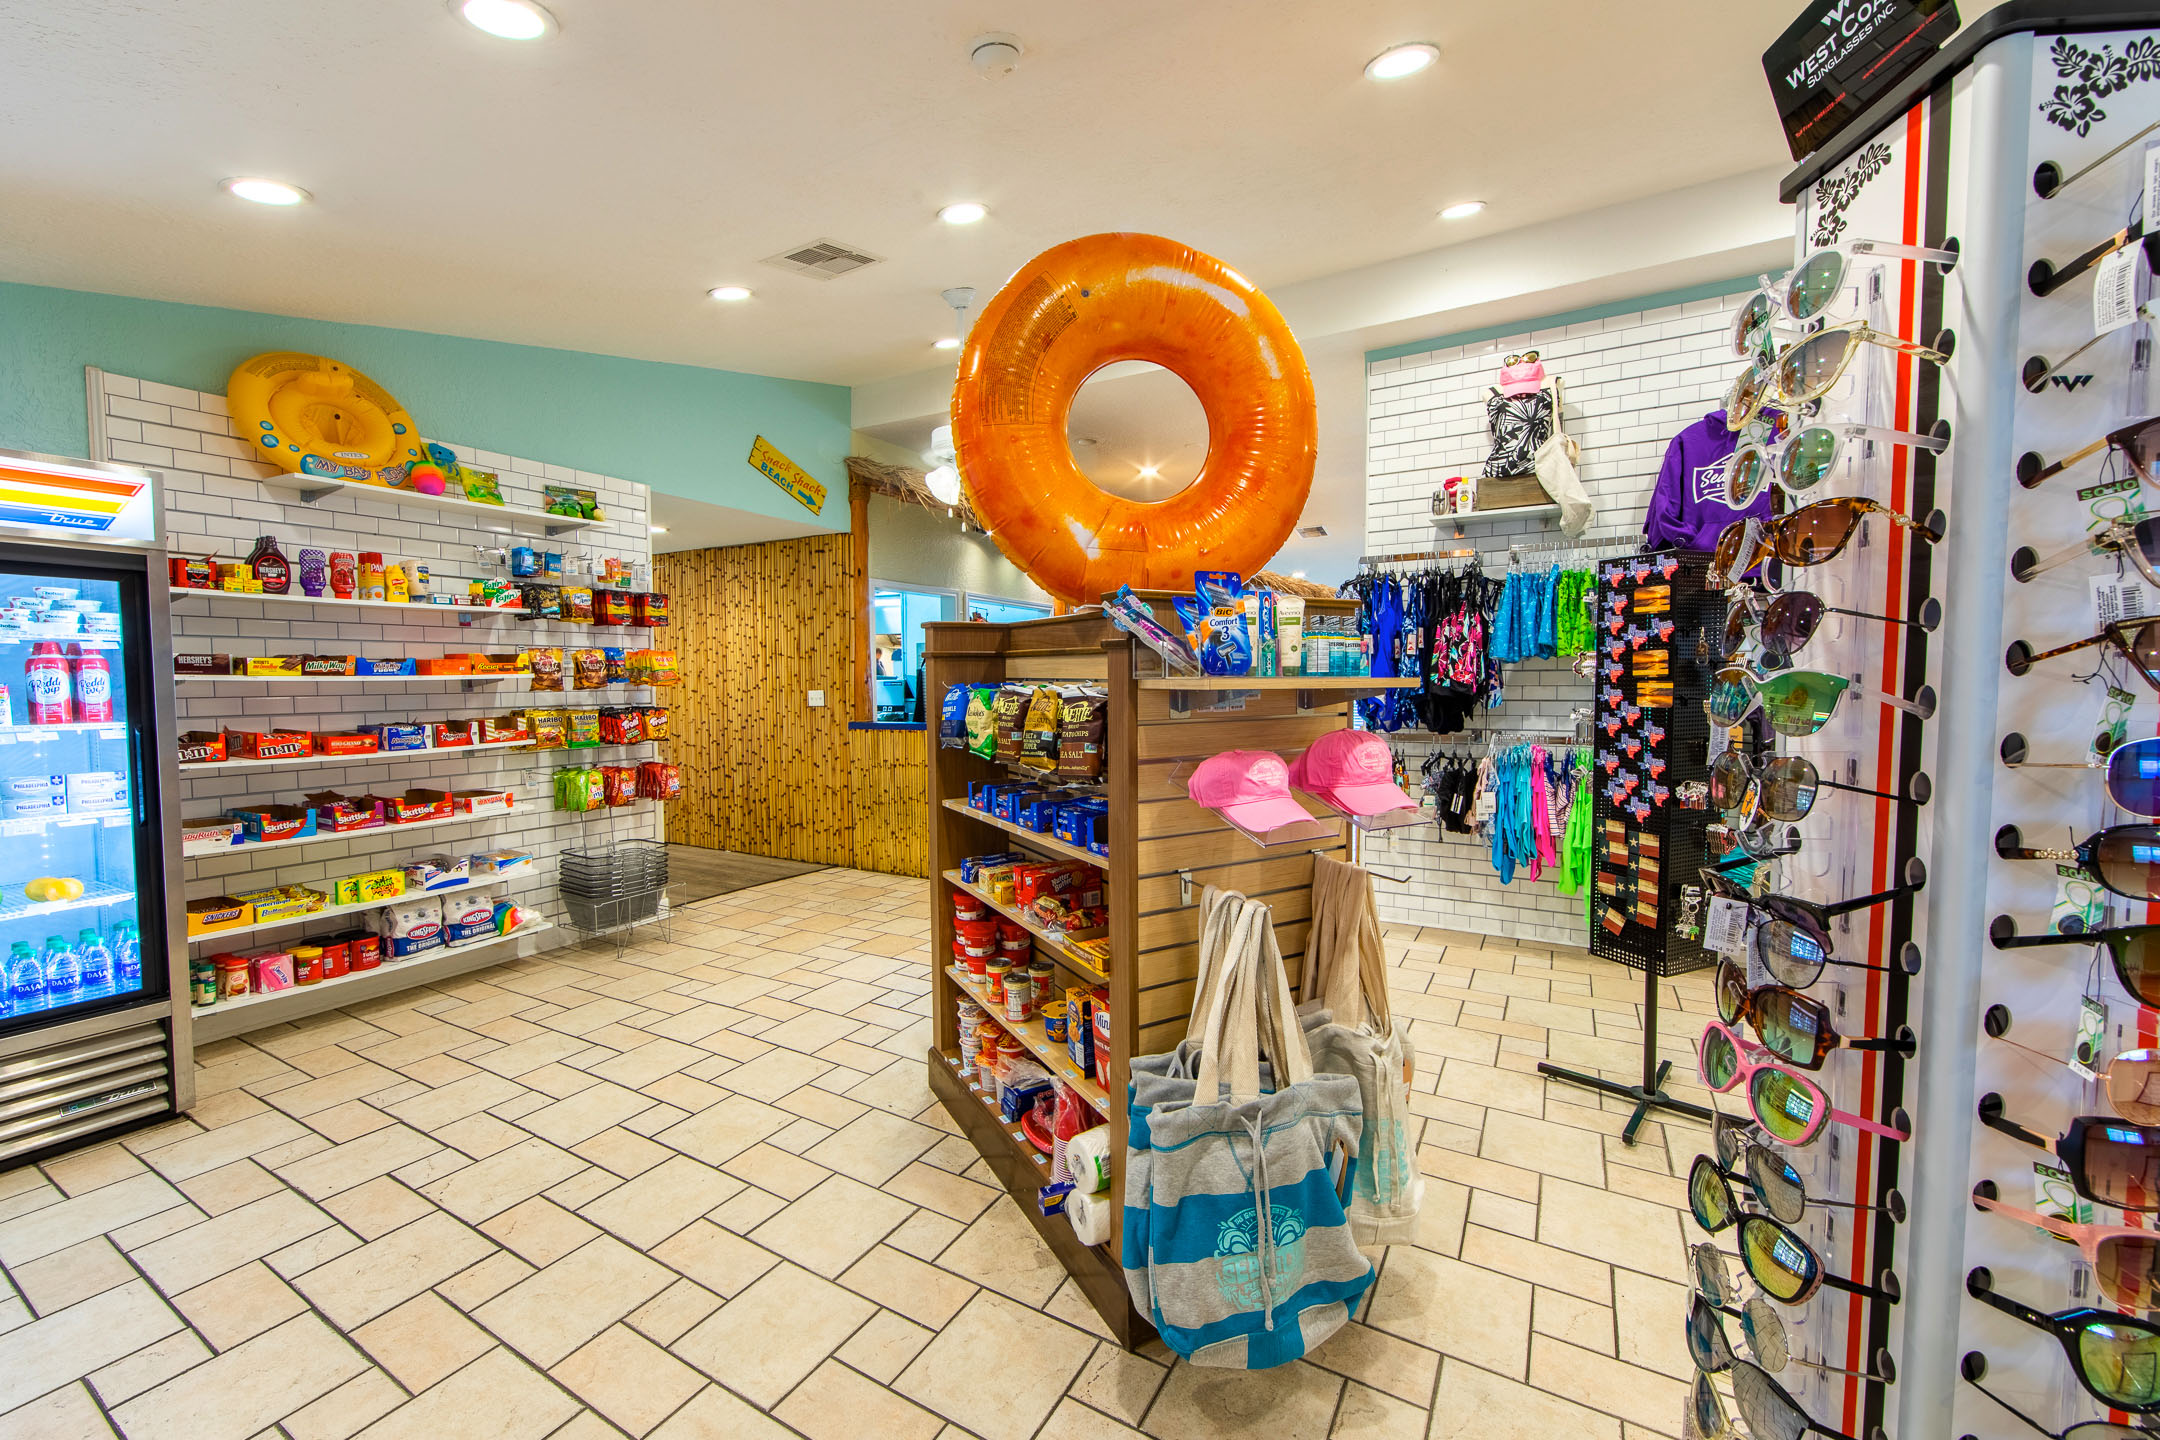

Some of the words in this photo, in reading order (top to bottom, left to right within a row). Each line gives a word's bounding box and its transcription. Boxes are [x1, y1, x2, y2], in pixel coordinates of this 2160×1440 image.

[1806, 24, 1873, 88] SUNGLASSES
[1874, 2, 1897, 27] INC.
[1785, 32, 1838, 90] WEST
[316, 459, 340, 473] MY
[760, 451, 792, 472] Snack
[792, 473, 822, 495] Shack
[761, 461, 794, 492] BEACH
[1209, 618, 1238, 627] Comfort
[1222, 626, 1230, 641] 3
[178, 656, 213, 664] HERSHEY'S
[538, 716, 563, 724] HARIBO
[1068, 750, 1084, 759] SALT
[400, 805, 435, 818] Skittles
[337, 812, 370, 825] Skittles
[264, 821, 300, 834] Skittles
[372, 879, 393, 889] SOUR
[1051, 872, 1071, 885] Nutter
[462, 911, 491, 924] KINGSFORD
[410, 926, 438, 937] KINGSFORD
[461, 929, 474, 937] THE
[472, 923, 496, 934] ORIGINAL
